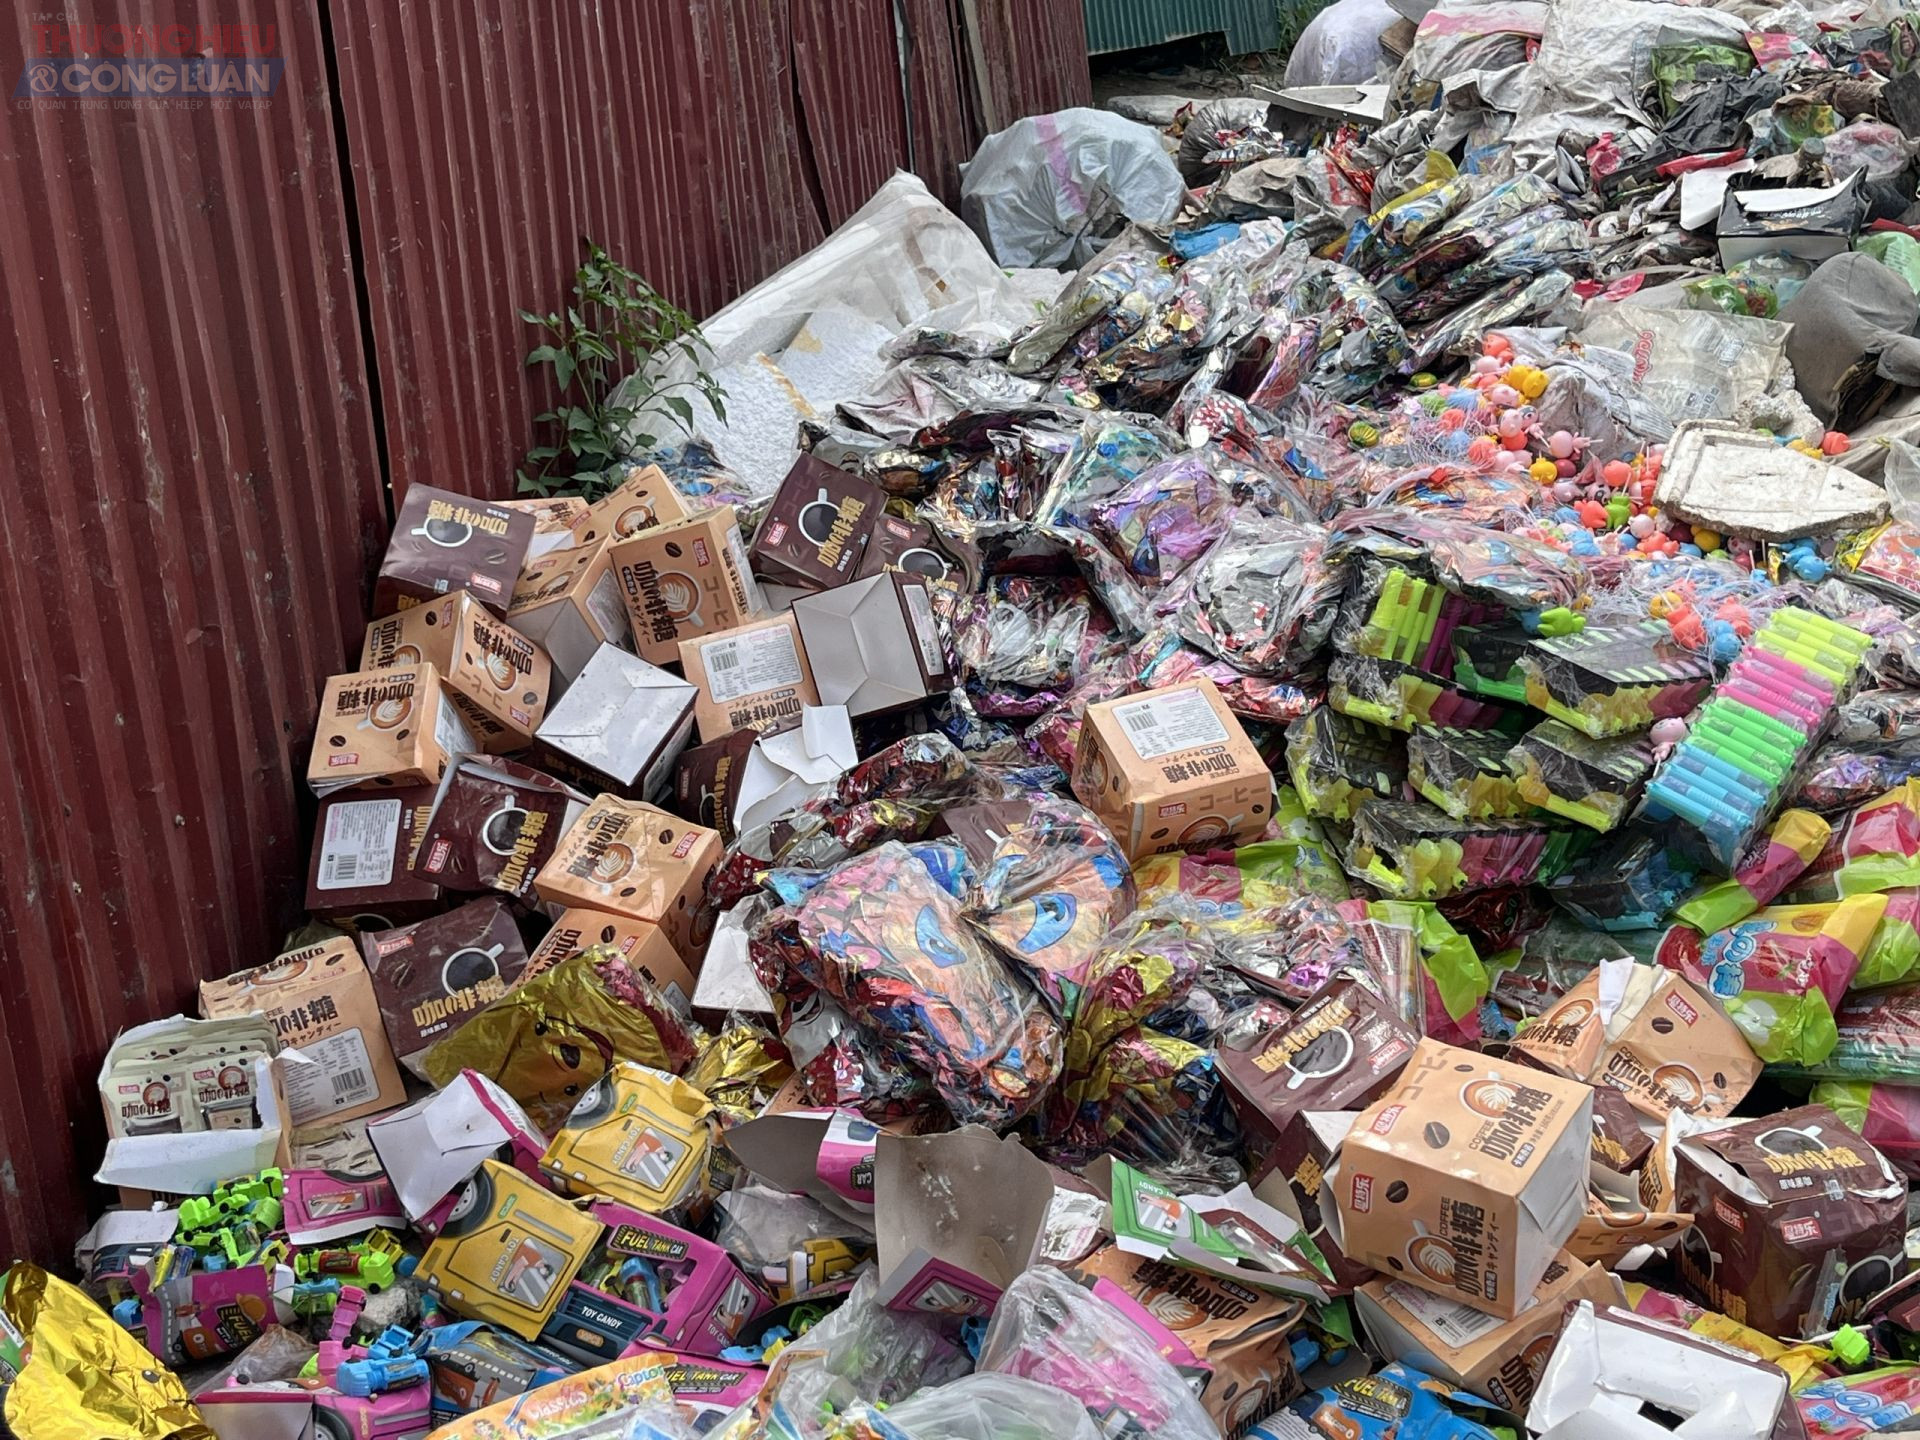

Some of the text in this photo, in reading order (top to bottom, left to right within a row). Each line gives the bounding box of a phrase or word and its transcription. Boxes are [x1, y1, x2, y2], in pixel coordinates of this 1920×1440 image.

[378, 620, 400, 669] 咖啡
[1199, 786, 1267, 811] コーヒー
[1469, 1120, 1495, 1150] COFFEE
[1480, 1085, 1553, 1161] 咖啡糖
[611, 1126, 641, 1166] TOY CANDY
[856, 1166, 873, 1185] CAR
[1138, 1180, 1164, 1195] CANDY
[1439, 1196, 1451, 1237] COFFEE
[621, 1231, 650, 1250] FUEL
[670, 1243, 685, 1255] CAR
[1450, 1200, 1486, 1297] 咖啡糖
[1485, 1212, 1501, 1270] キャンディー
[490, 1237, 520, 1284] TOY CANDY
[228, 1315, 252, 1341] FUEL
[581, 1305, 623, 1329] TOY CANDY
[707, 1323, 718, 1338] TOY
[665, 1369, 687, 1382] UEL
[1344, 1379, 1376, 1398] FUEL
